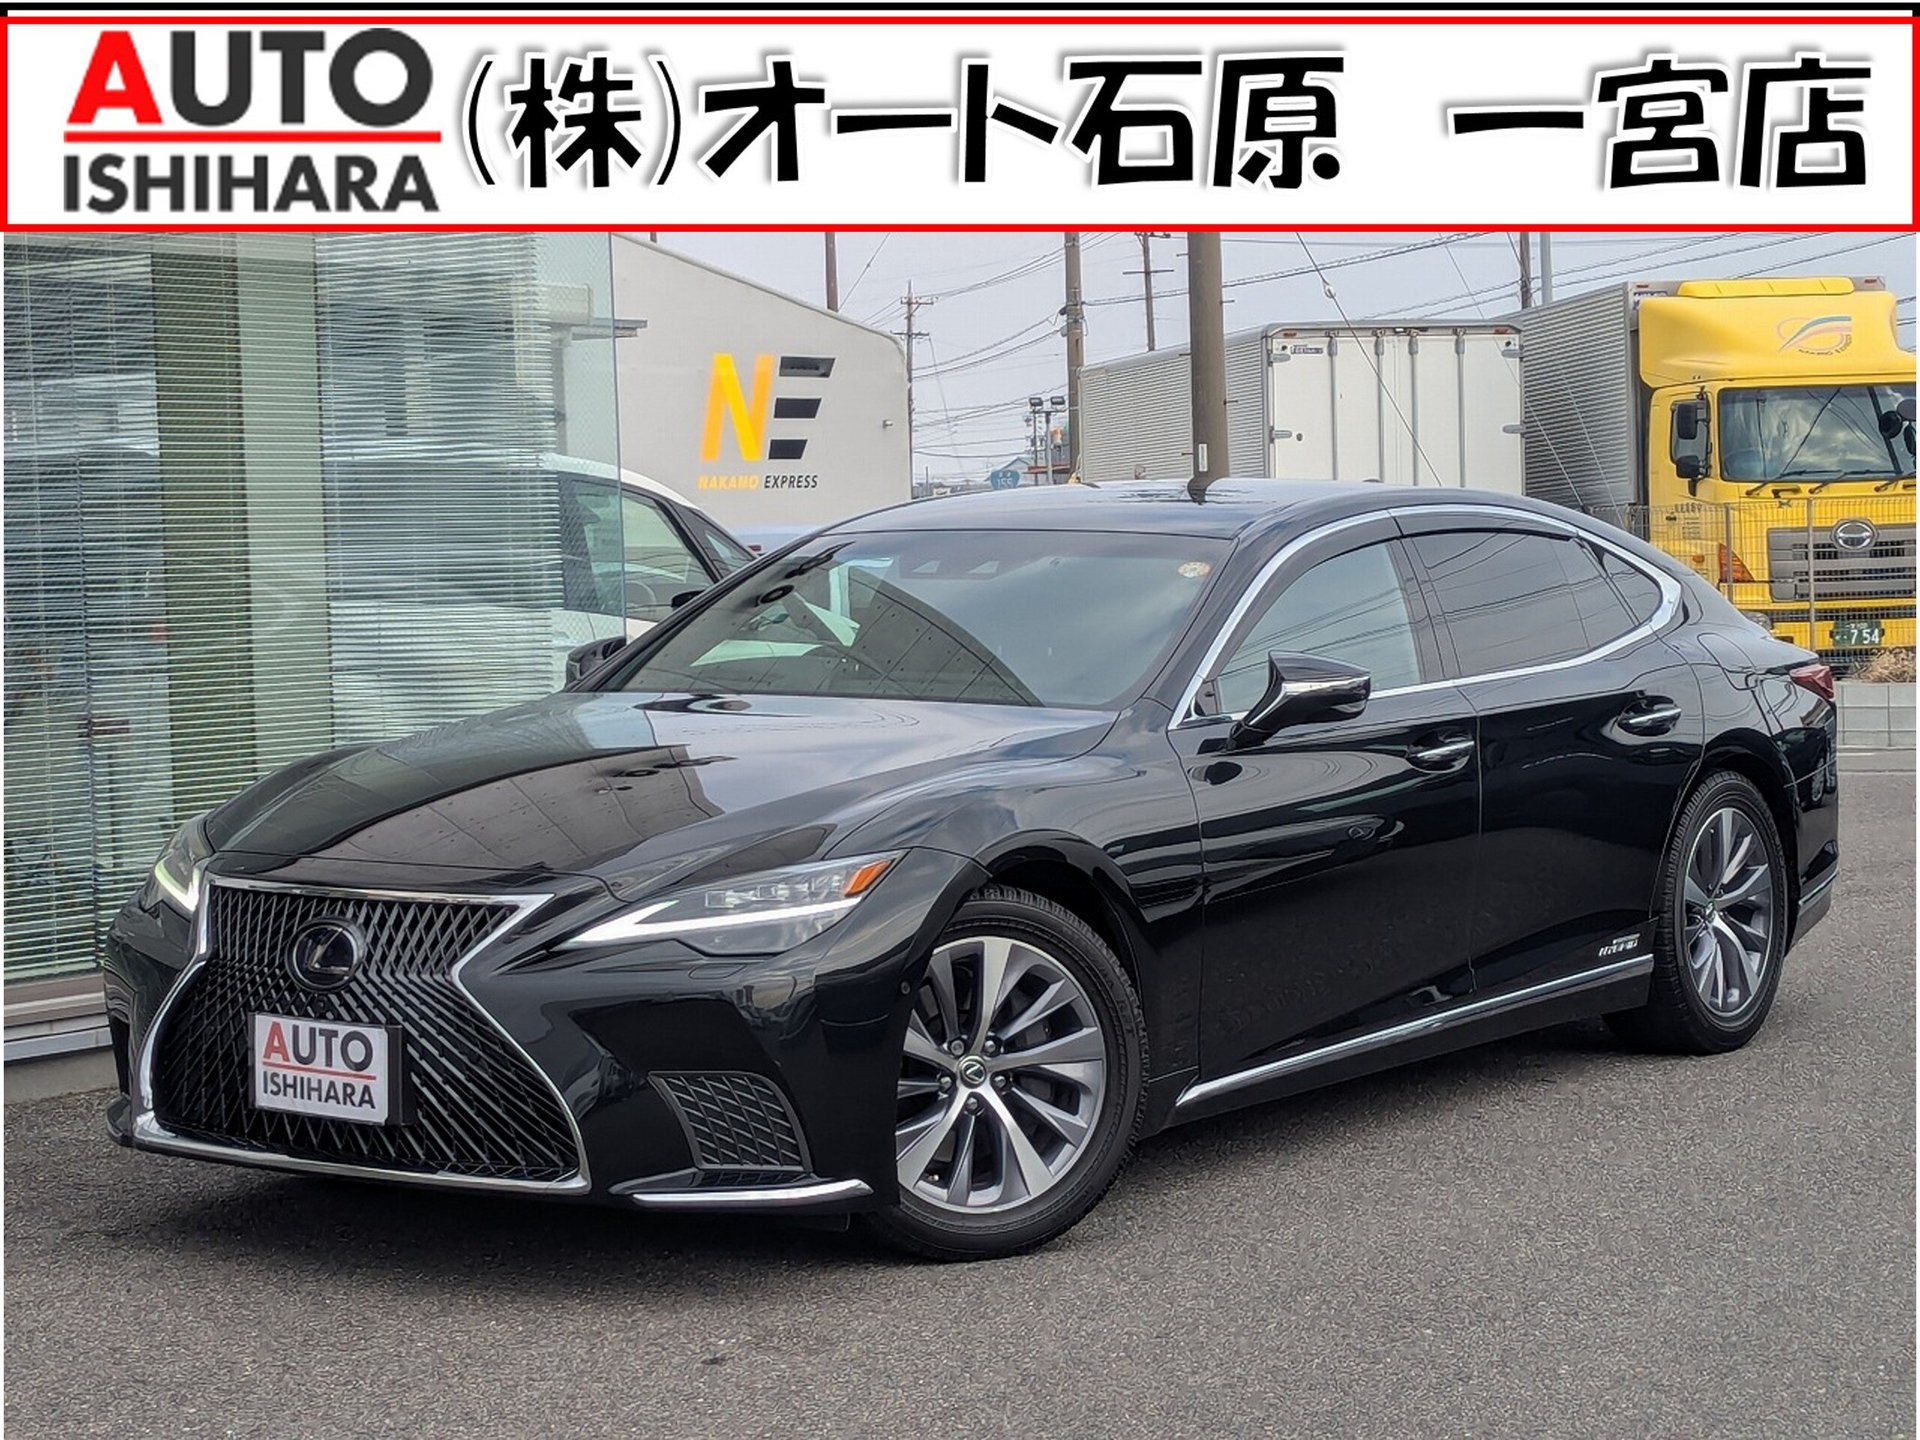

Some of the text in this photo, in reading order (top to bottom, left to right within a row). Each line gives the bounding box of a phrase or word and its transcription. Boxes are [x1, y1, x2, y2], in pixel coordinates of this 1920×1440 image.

[763, 474, 819, 489] EXPRESS
[263, 1021, 374, 1073] AUTO
[263, 1070, 377, 1110] ISHIHARA
